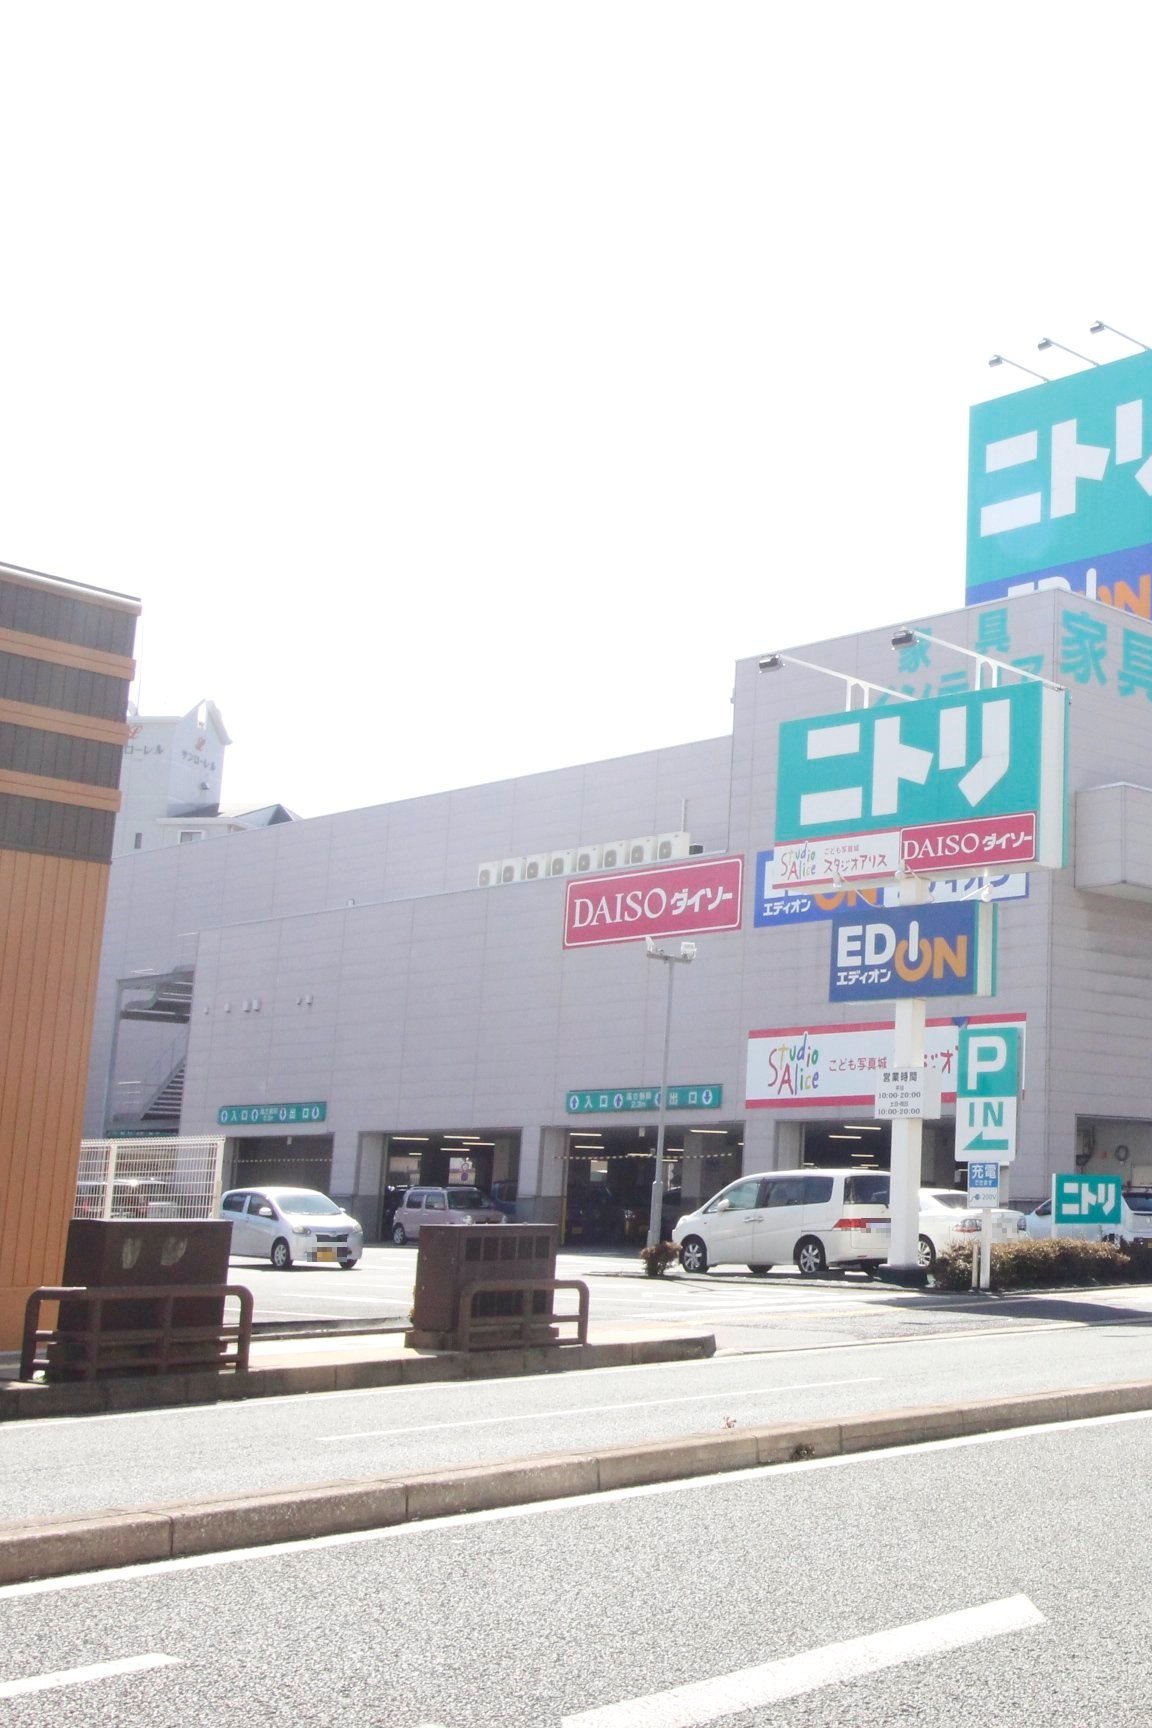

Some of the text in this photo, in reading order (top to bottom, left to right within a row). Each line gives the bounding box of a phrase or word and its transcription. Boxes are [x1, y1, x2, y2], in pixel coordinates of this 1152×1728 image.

[124, 744, 164, 755] ローレル
[800, 699, 1010, 825] ニトリ
[903, 829, 1033, 860] DAISO ダイソー
[824, 854, 888, 873] スタジオアリス
[572, 886, 733, 928] DAISO ダイソー
[763, 899, 810, 916] エディオン
[836, 920, 967, 982] EDION
[836, 969, 891, 985] エディオン
[768, 1032, 819, 1087] Studio
[829, 1057, 887, 1071] こども写真城
[967, 1036, 1007, 1090] P
[777, 1063, 819, 1096] Alice
[883, 1071, 917, 1082] 営業時間
[584, 1095, 608, 1108] 入口
[669, 1091, 697, 1105] 出口
[230, 1110, 248, 1121] 入口
[968, 1101, 1004, 1128] IN
[971, 1164, 997, 1179] 充電
[1062, 1183, 1115, 1216] ニトリ
